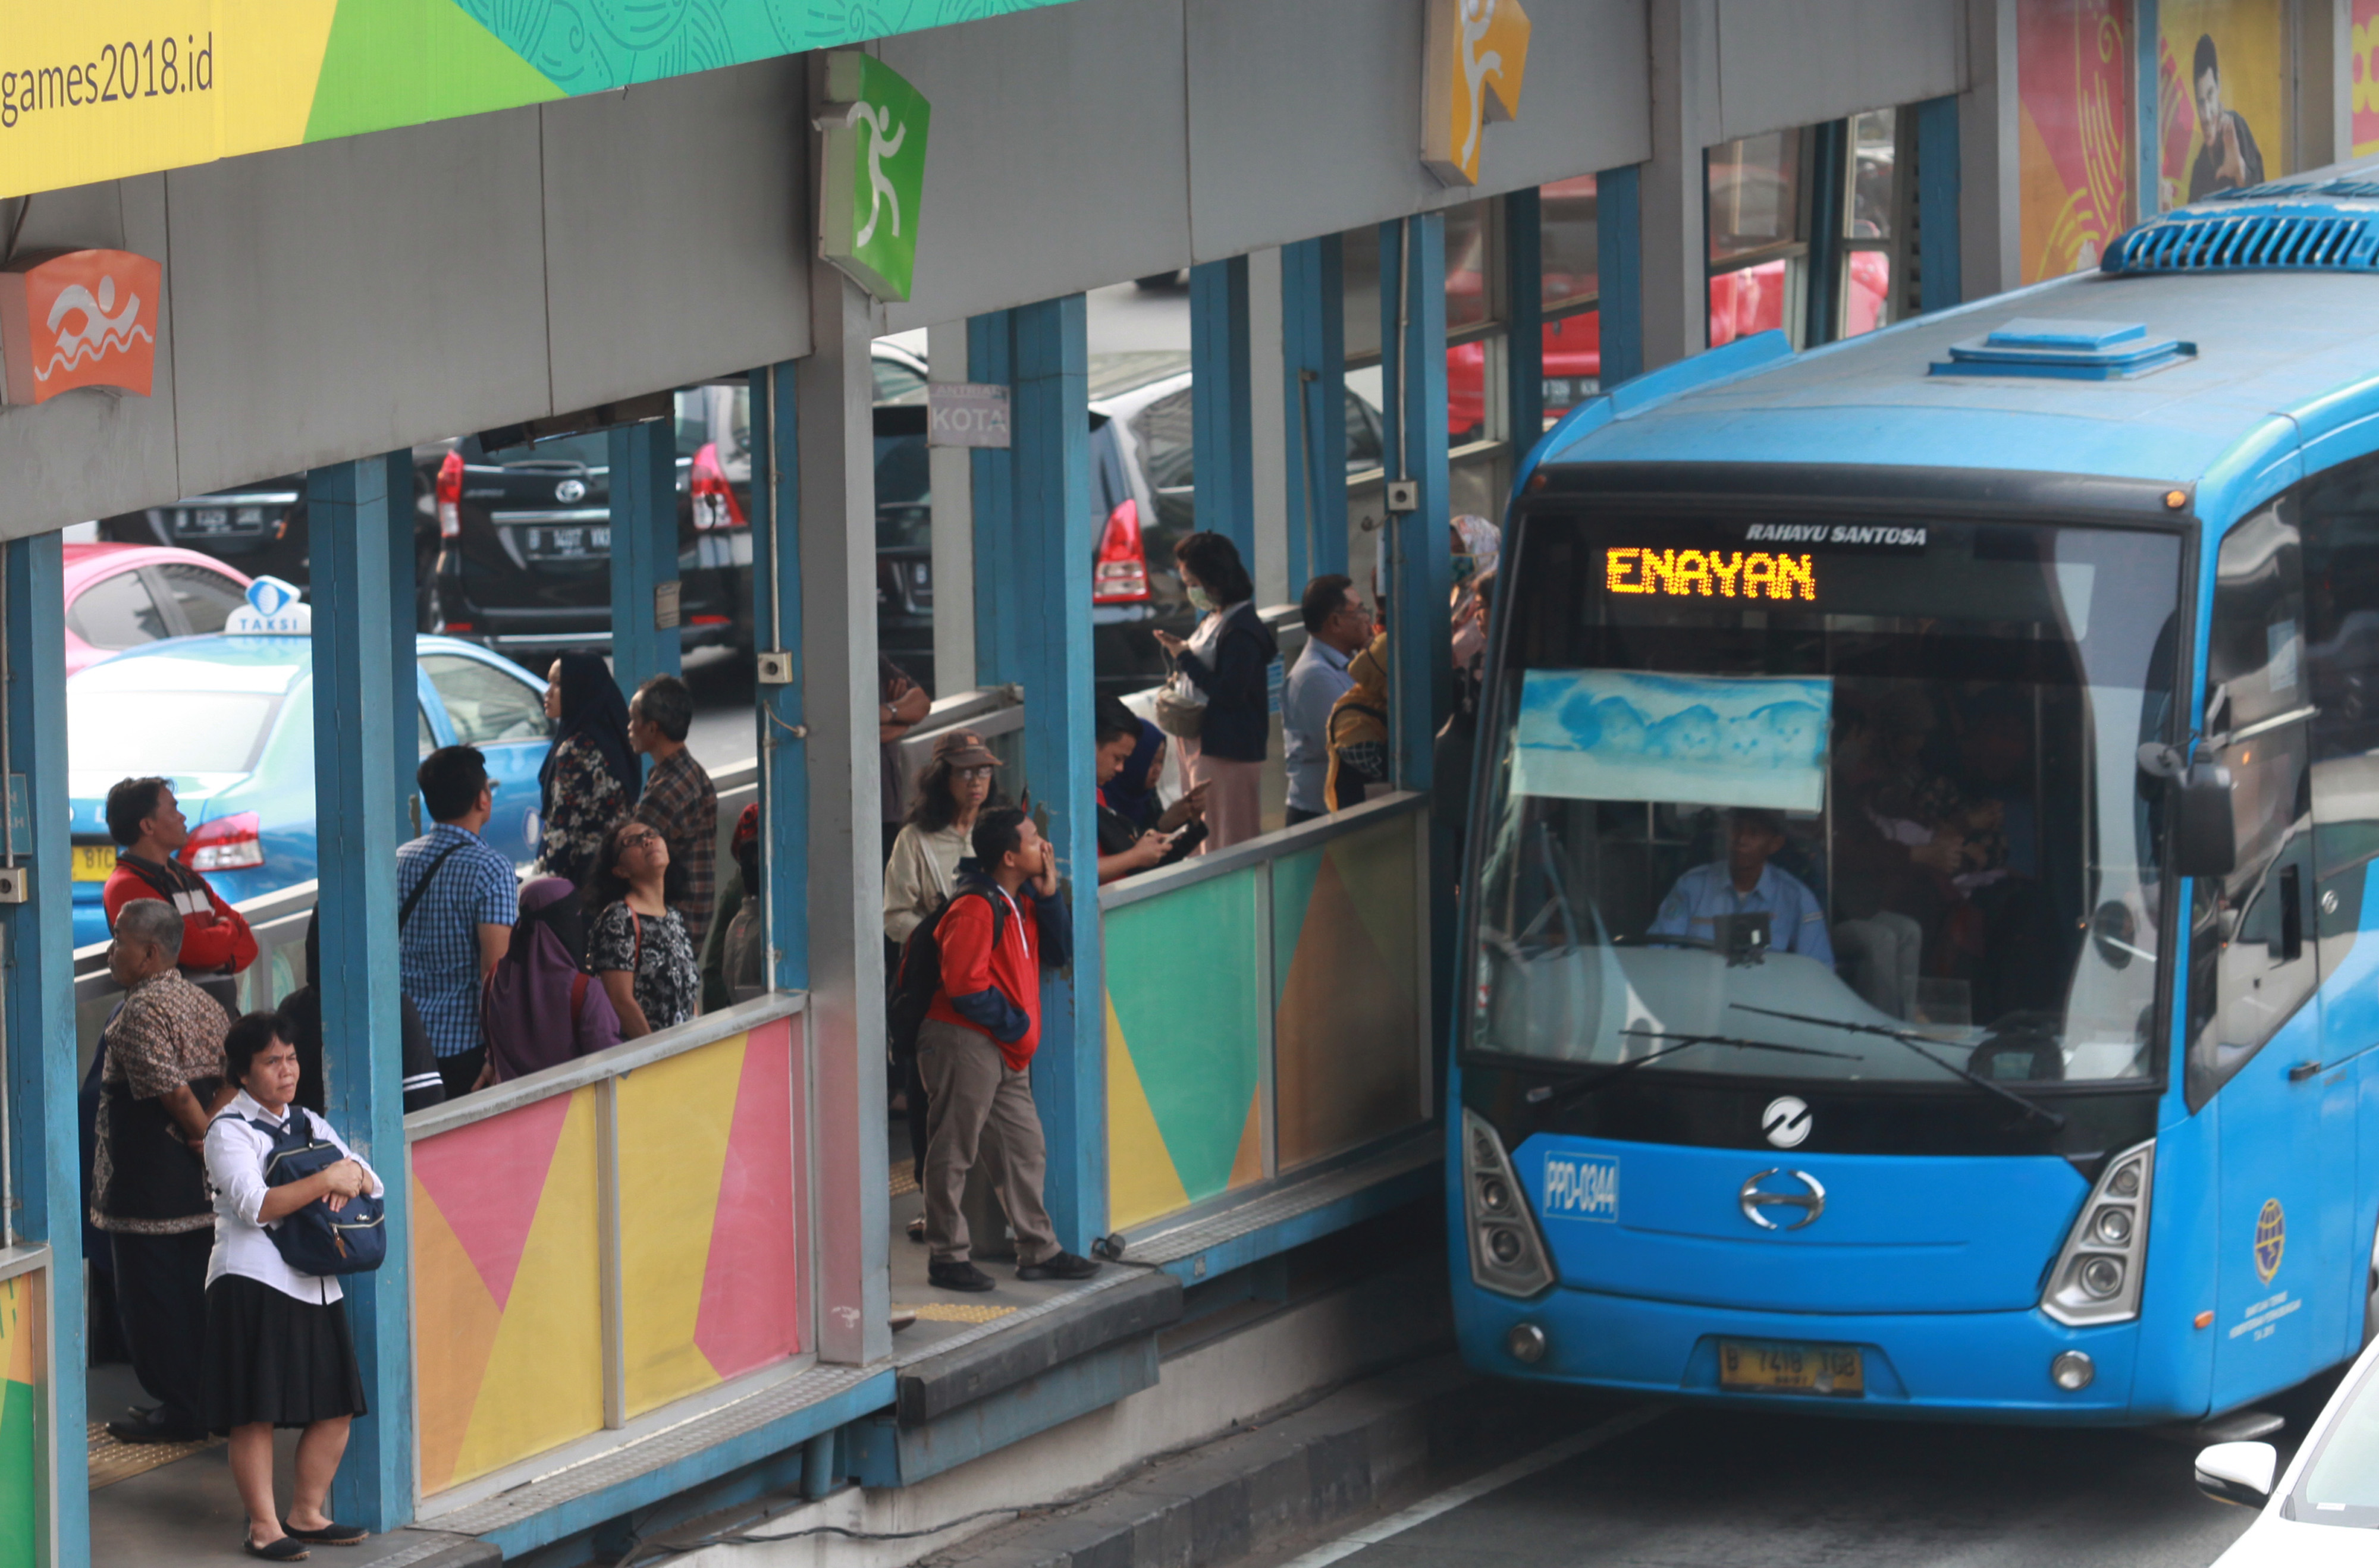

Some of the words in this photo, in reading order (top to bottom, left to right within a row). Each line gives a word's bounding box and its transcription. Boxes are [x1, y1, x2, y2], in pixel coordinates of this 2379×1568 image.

[1, 31, 212, 128] games2018.id
[931, 408, 1006, 432] KOTA
[1746, 523, 1829, 542] RAHAYU
[1831, 525, 1926, 546] SANTOSA
[1606, 548, 1815, 601] ENAYAN
[240, 618, 297, 630] TAKSI
[1546, 1161, 1615, 1214] PPD-0344
[1727, 1347, 1738, 1371] B
